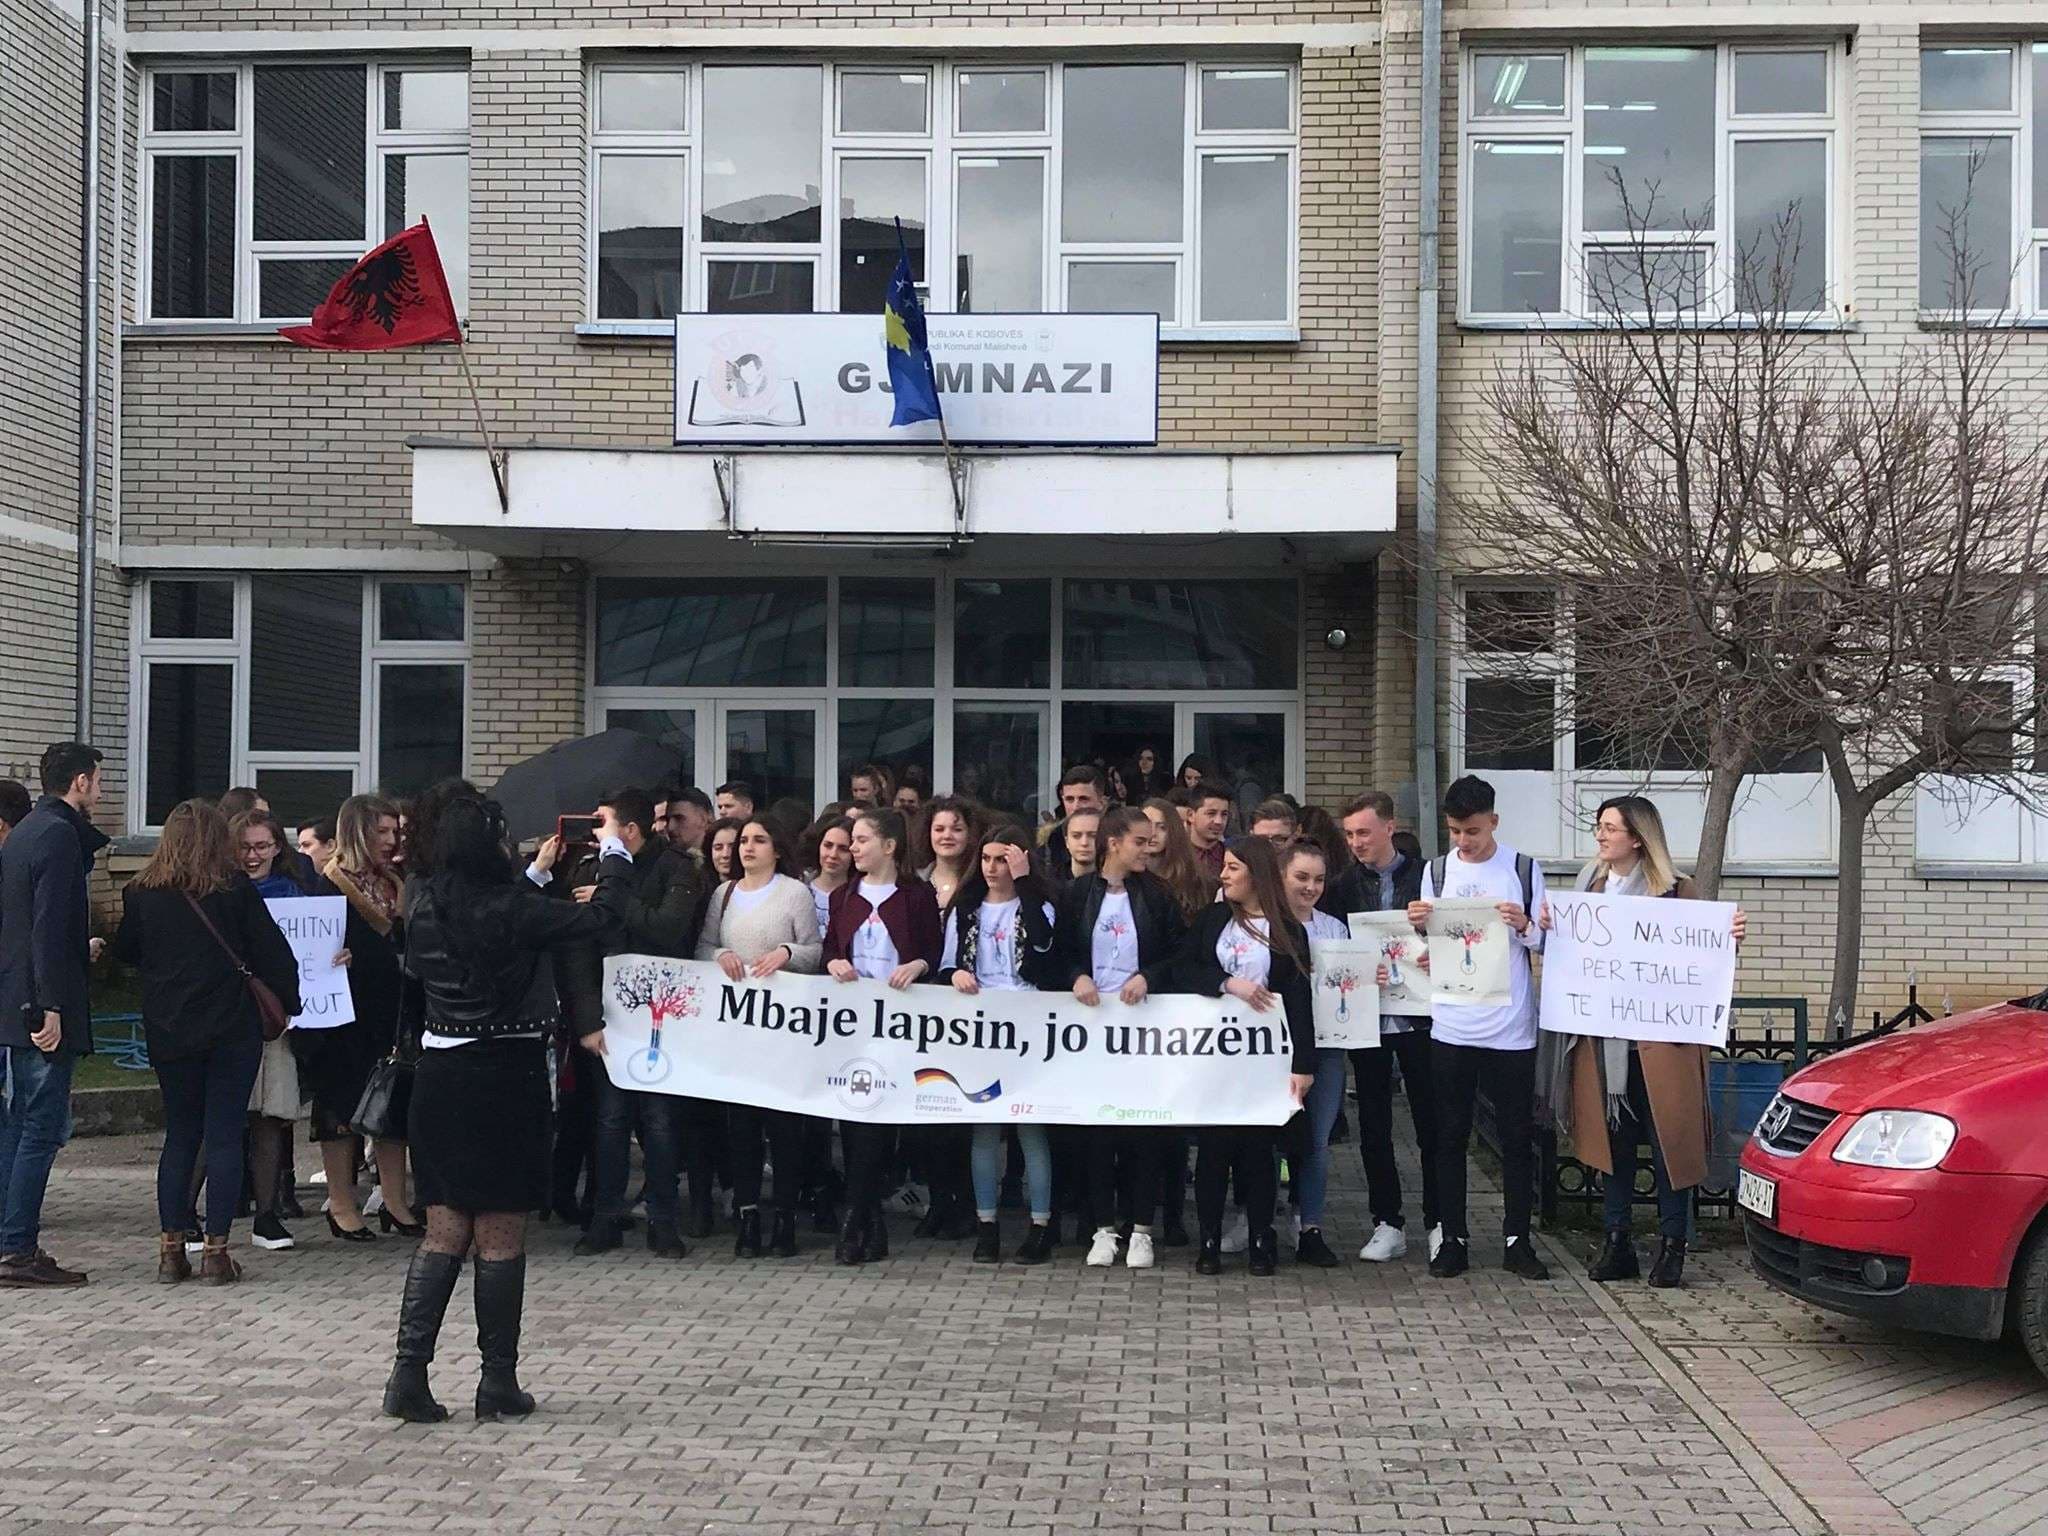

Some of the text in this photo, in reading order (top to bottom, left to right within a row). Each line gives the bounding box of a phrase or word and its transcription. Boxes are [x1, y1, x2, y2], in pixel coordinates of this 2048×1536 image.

[927, 329, 965, 339] PUBLIKA
[1552, 902, 1612, 947] MOS
[1634, 920, 1664, 944] NA
[1583, 957, 1625, 982] PER
[1566, 992, 1725, 1030] TE HALLKUT!
[717, 984, 1290, 1063] Mbaje lapsin, jo unazën!
[874, 1079, 898, 1089] BUS
[915, 1093, 957, 1105] german
[915, 1104, 963, 1113] cooperation
[1010, 1103, 1034, 1116] giz
[1116, 1107, 1173, 1121] germin
